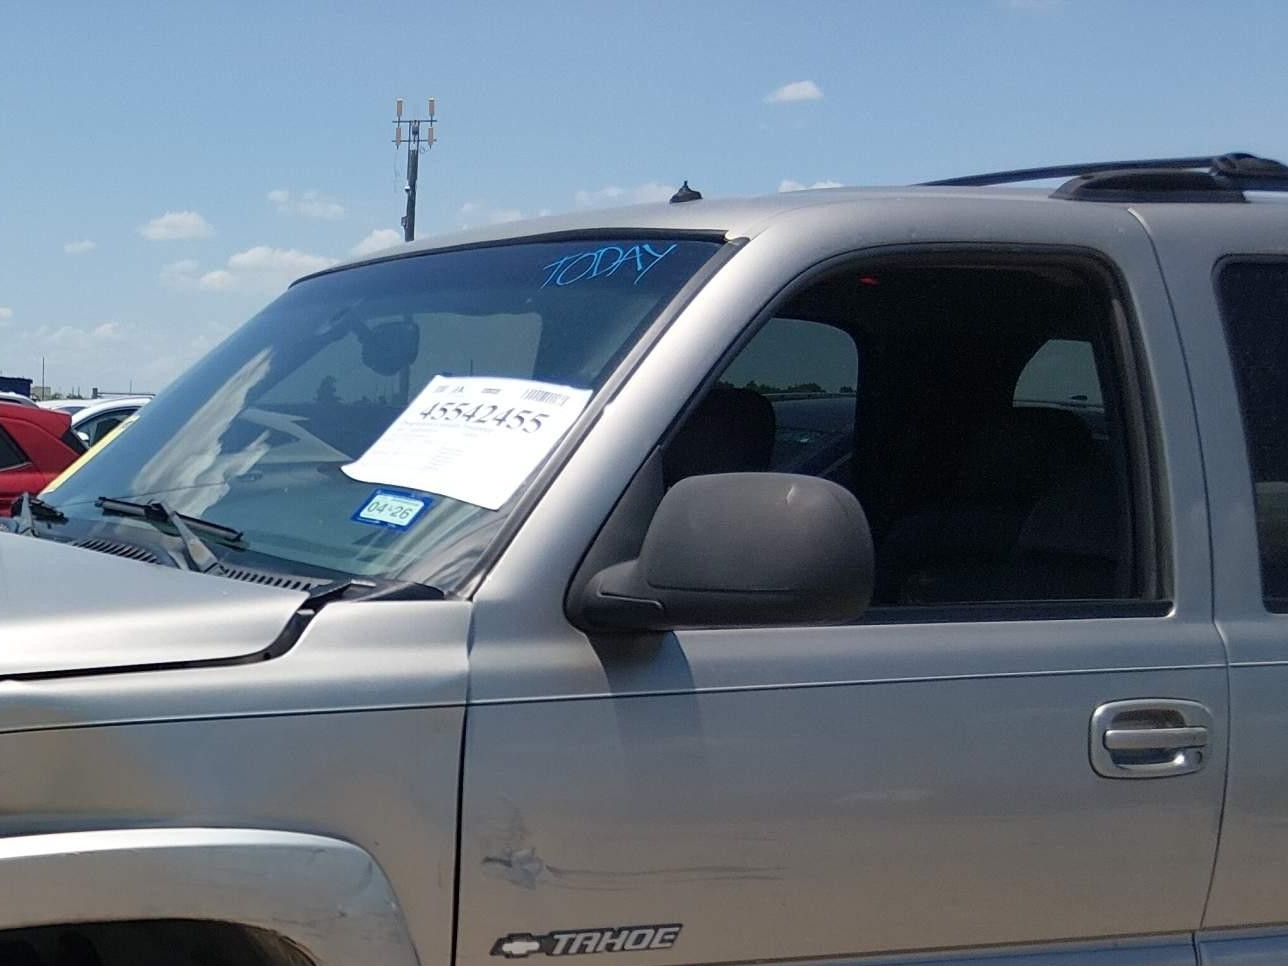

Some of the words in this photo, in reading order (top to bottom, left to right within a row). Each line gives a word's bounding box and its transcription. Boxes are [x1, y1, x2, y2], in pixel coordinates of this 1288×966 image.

[541, 243, 678, 288] TODAY
[420, 401, 550, 434] 45542455
[548, 925, 682, 956] TAHOE
